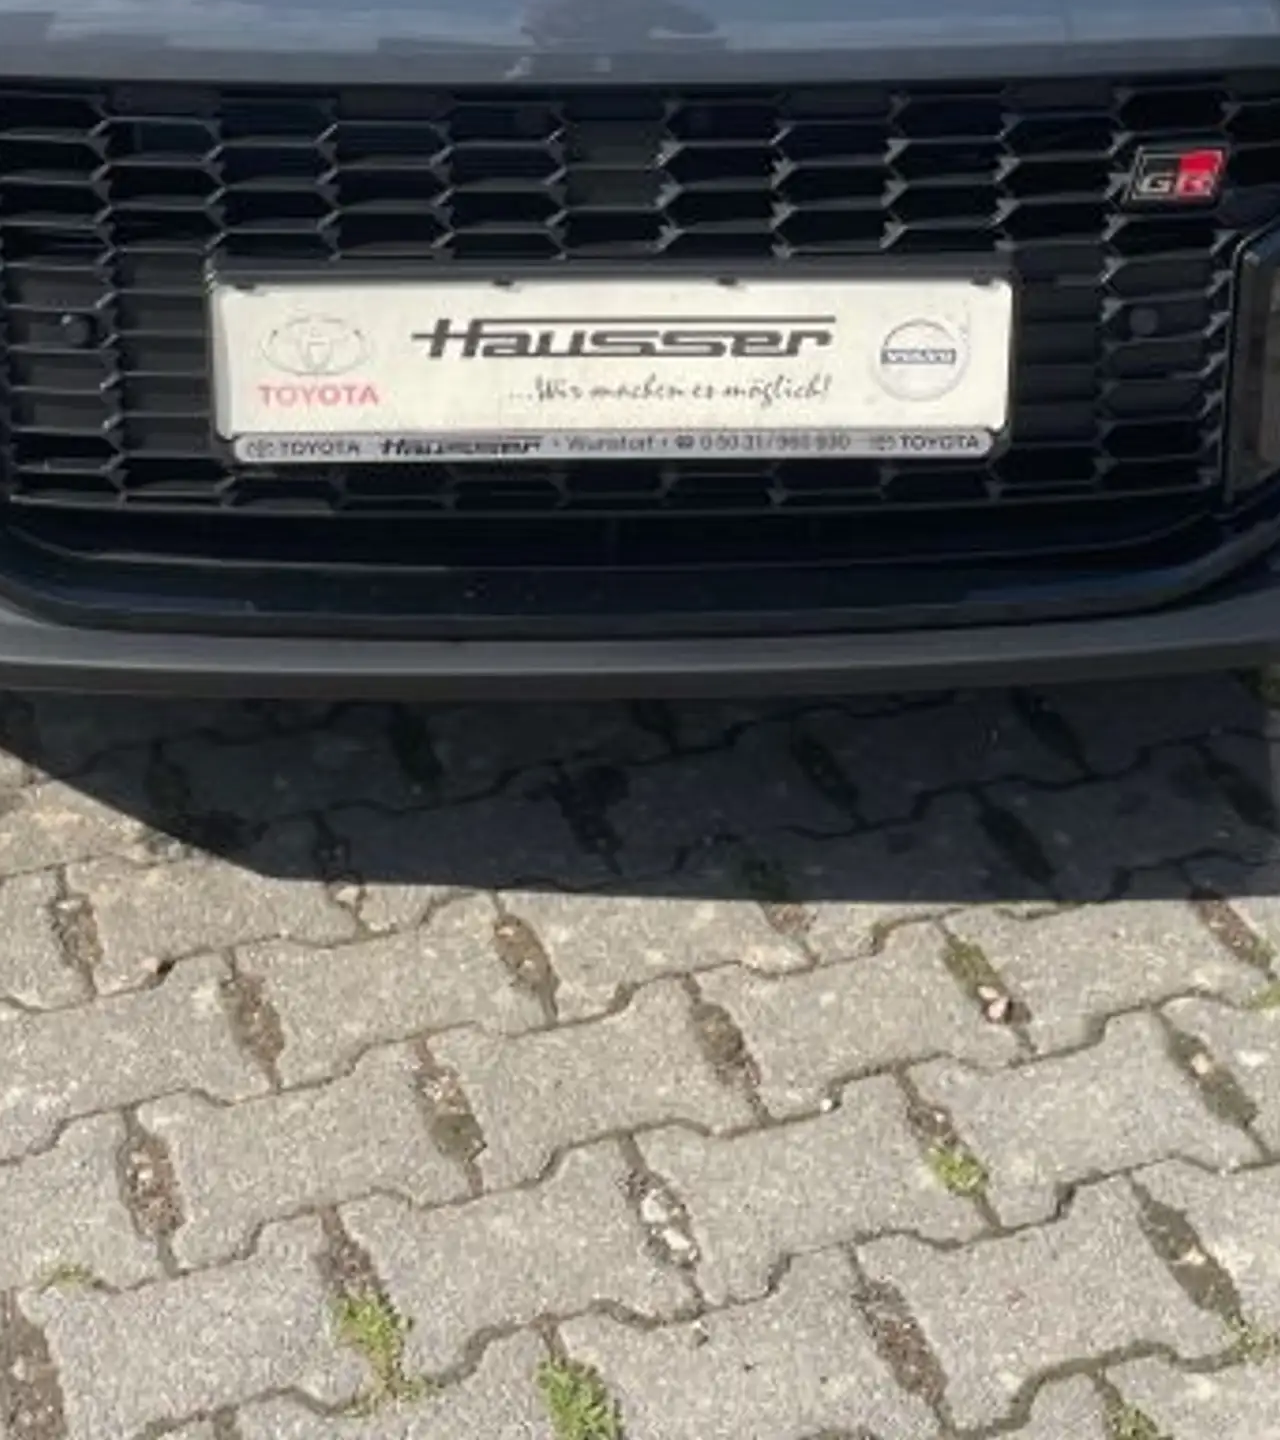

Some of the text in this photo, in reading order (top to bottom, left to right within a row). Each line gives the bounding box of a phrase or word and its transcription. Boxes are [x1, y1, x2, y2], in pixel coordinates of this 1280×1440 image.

[1140, 172, 1214, 196] GR
[411, 316, 836, 358] Hausser
[258, 385, 380, 407] TOYOTA
[281, 439, 361, 456] TOYOTA
[900, 433, 980, 449] TOYOTA
